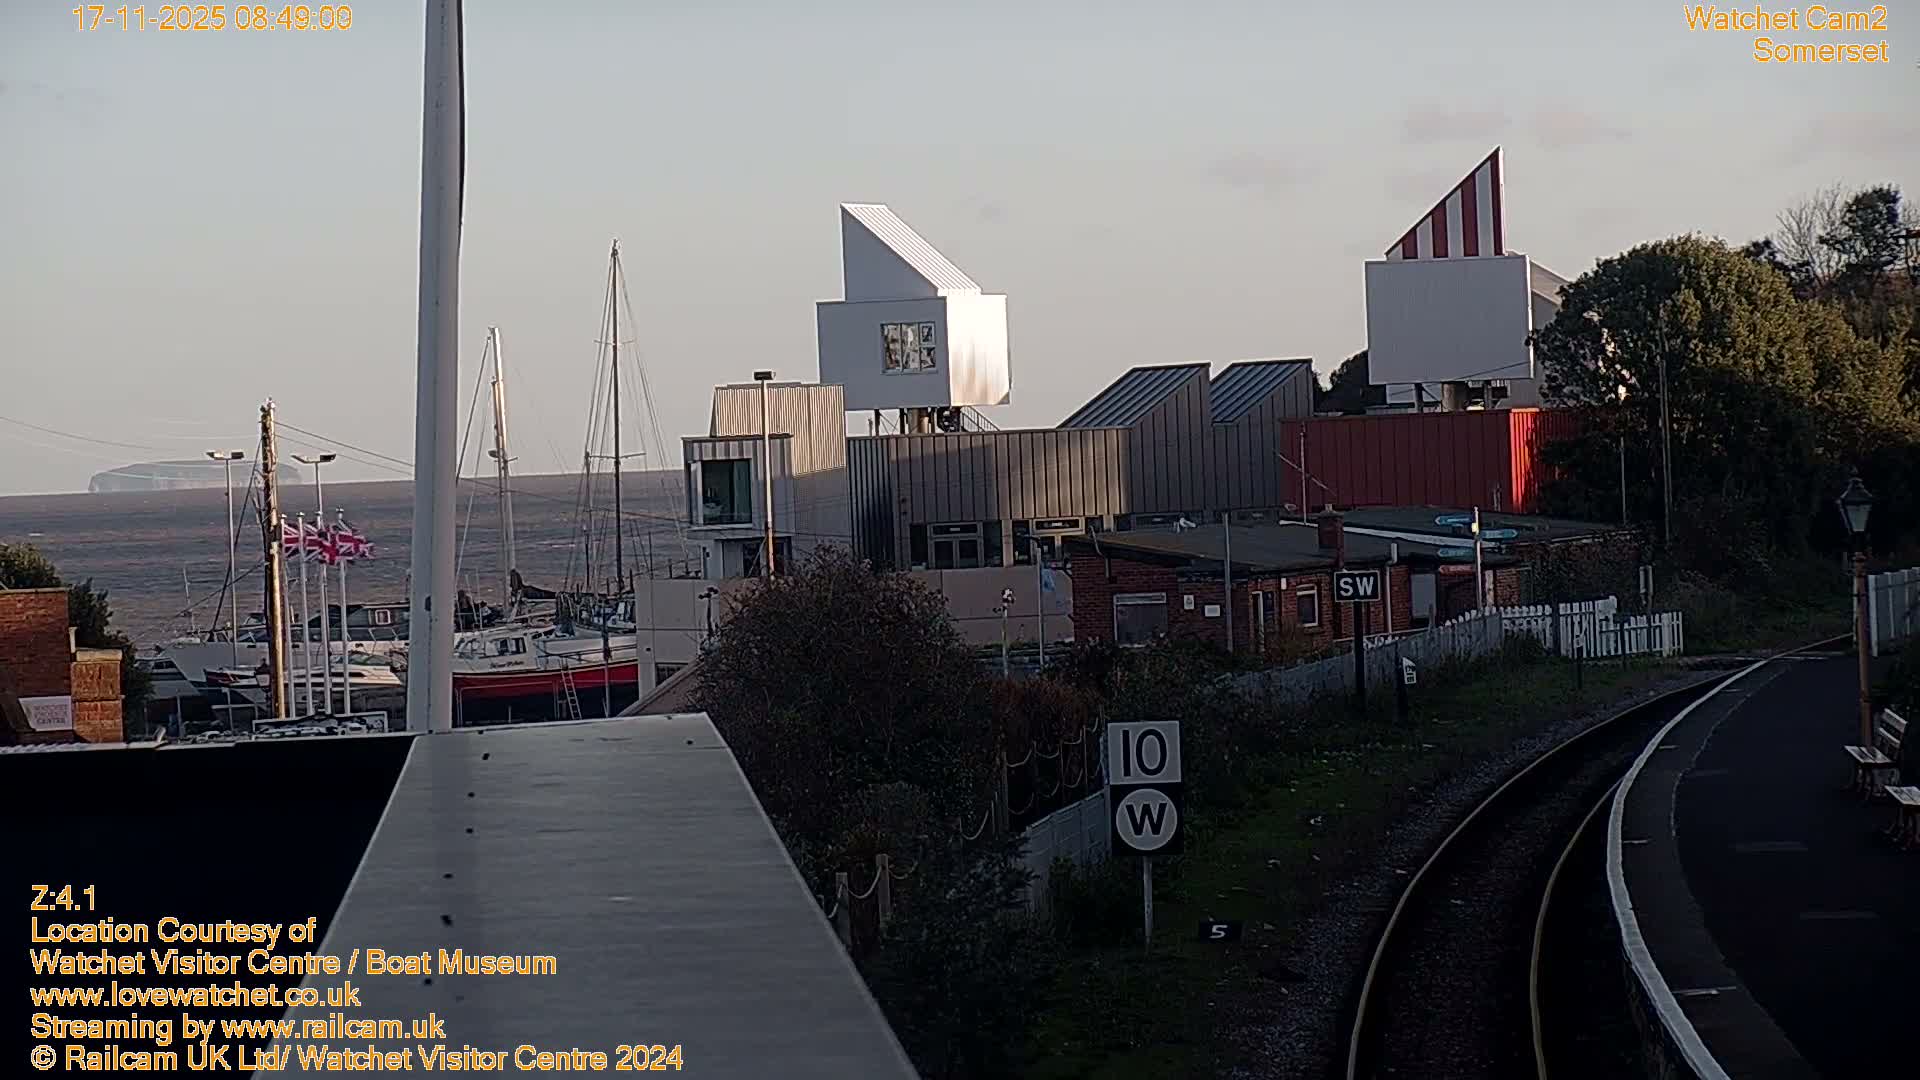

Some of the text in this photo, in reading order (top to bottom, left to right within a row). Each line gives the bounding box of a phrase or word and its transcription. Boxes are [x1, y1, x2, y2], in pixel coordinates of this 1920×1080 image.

[1339, 575, 1375, 597] SW
[1121, 728, 1168, 777] 10
[1125, 802, 1168, 837] W
